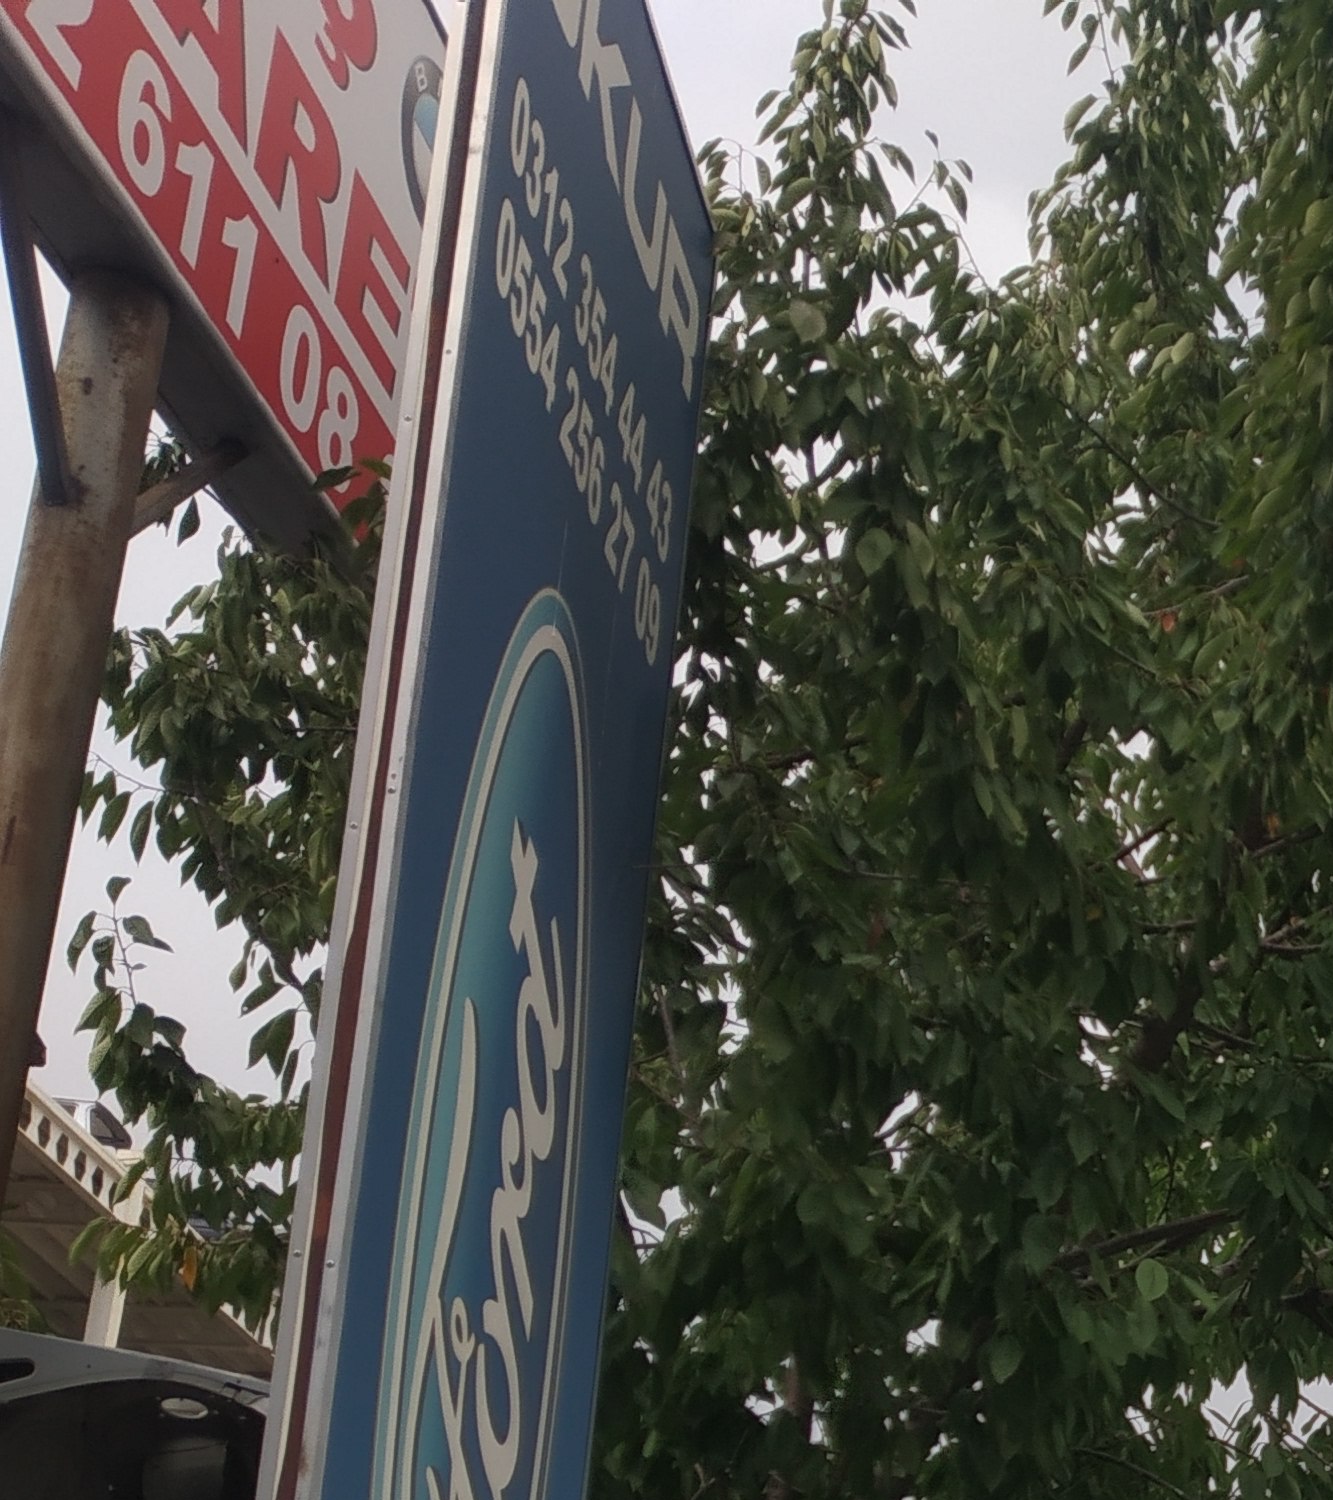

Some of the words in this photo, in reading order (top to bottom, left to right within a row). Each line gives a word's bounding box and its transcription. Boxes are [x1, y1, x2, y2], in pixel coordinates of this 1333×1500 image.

[117, 48, 259, 341] 611
[279, 304, 360, 494] 08
[495, 197, 560, 414] 0554
[559, 366, 606, 526] 256
[605, 481, 636, 594] 27
[635, 556, 661, 667] 09
[511, 77, 574, 299] 0312
[575, 253, 618, 417] 354
[618, 381, 647, 495] 44
[646, 459, 672, 564] 43
